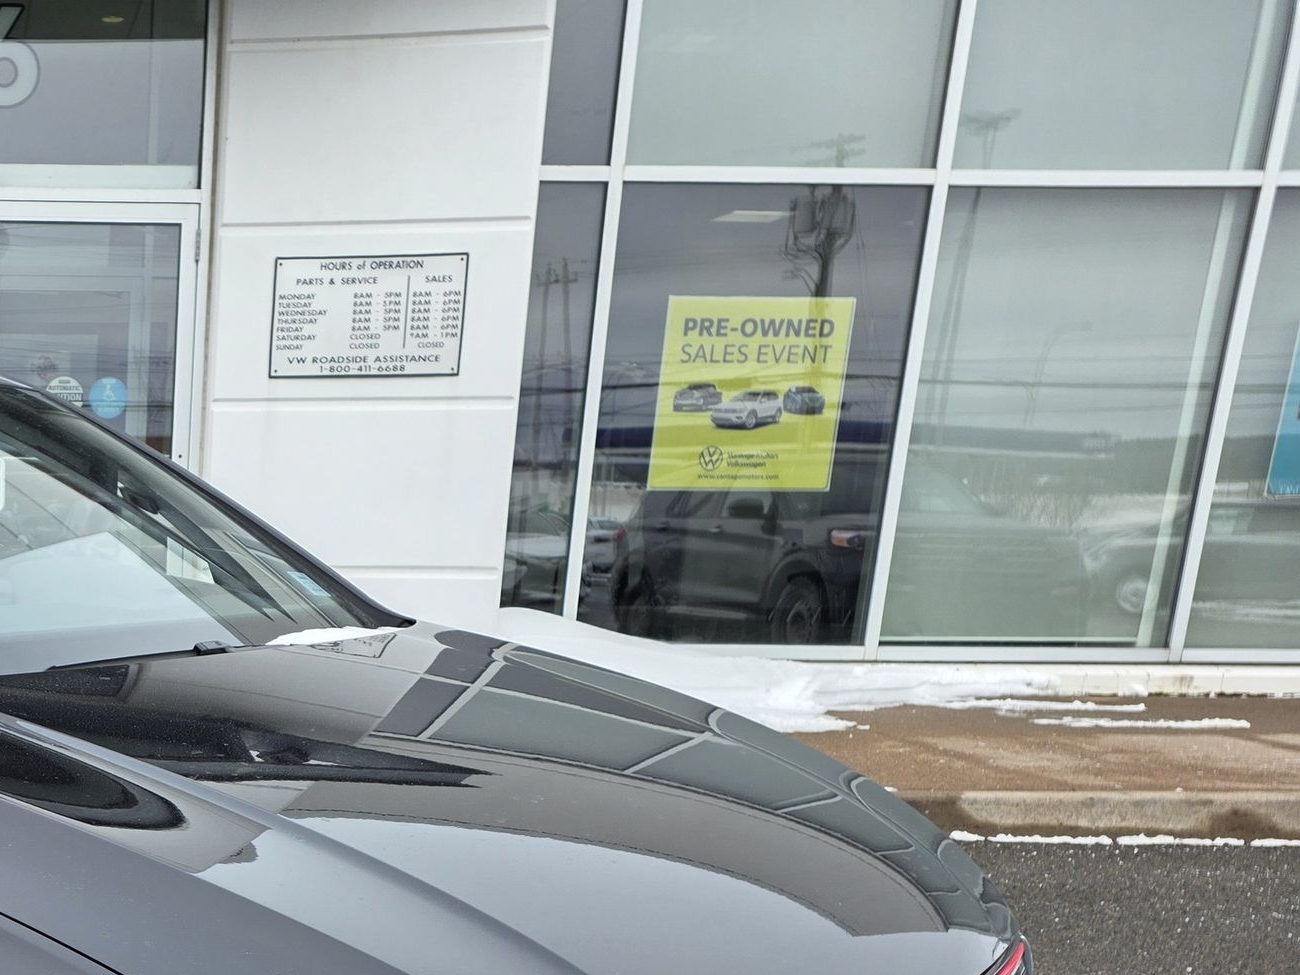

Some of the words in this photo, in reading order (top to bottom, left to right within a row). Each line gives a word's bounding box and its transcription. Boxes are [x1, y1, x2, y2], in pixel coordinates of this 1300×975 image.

[320, 261, 353, 271] HOURS
[356, 260, 366, 270] of
[370, 259, 424, 270] OPERATION
[296, 277, 325, 286] PARTS
[341, 277, 379, 286] SERVICE
[425, 274, 453, 283] SALES
[278, 293, 316, 301] MONDAY
[683, 317, 835, 338] PRE-OWNED
[275, 343, 303, 351] SUNDAY
[417, 341, 445, 349] CLOSED
[680, 343, 749, 363] SALES
[756, 343, 833, 364] EVENT
[287, 356, 307, 364] VW
[312, 355, 369, 364] ROADSIDE
[374, 354, 441, 363] ASSISTANCE
[320, 364, 406, 373] 1-800-411-6688
